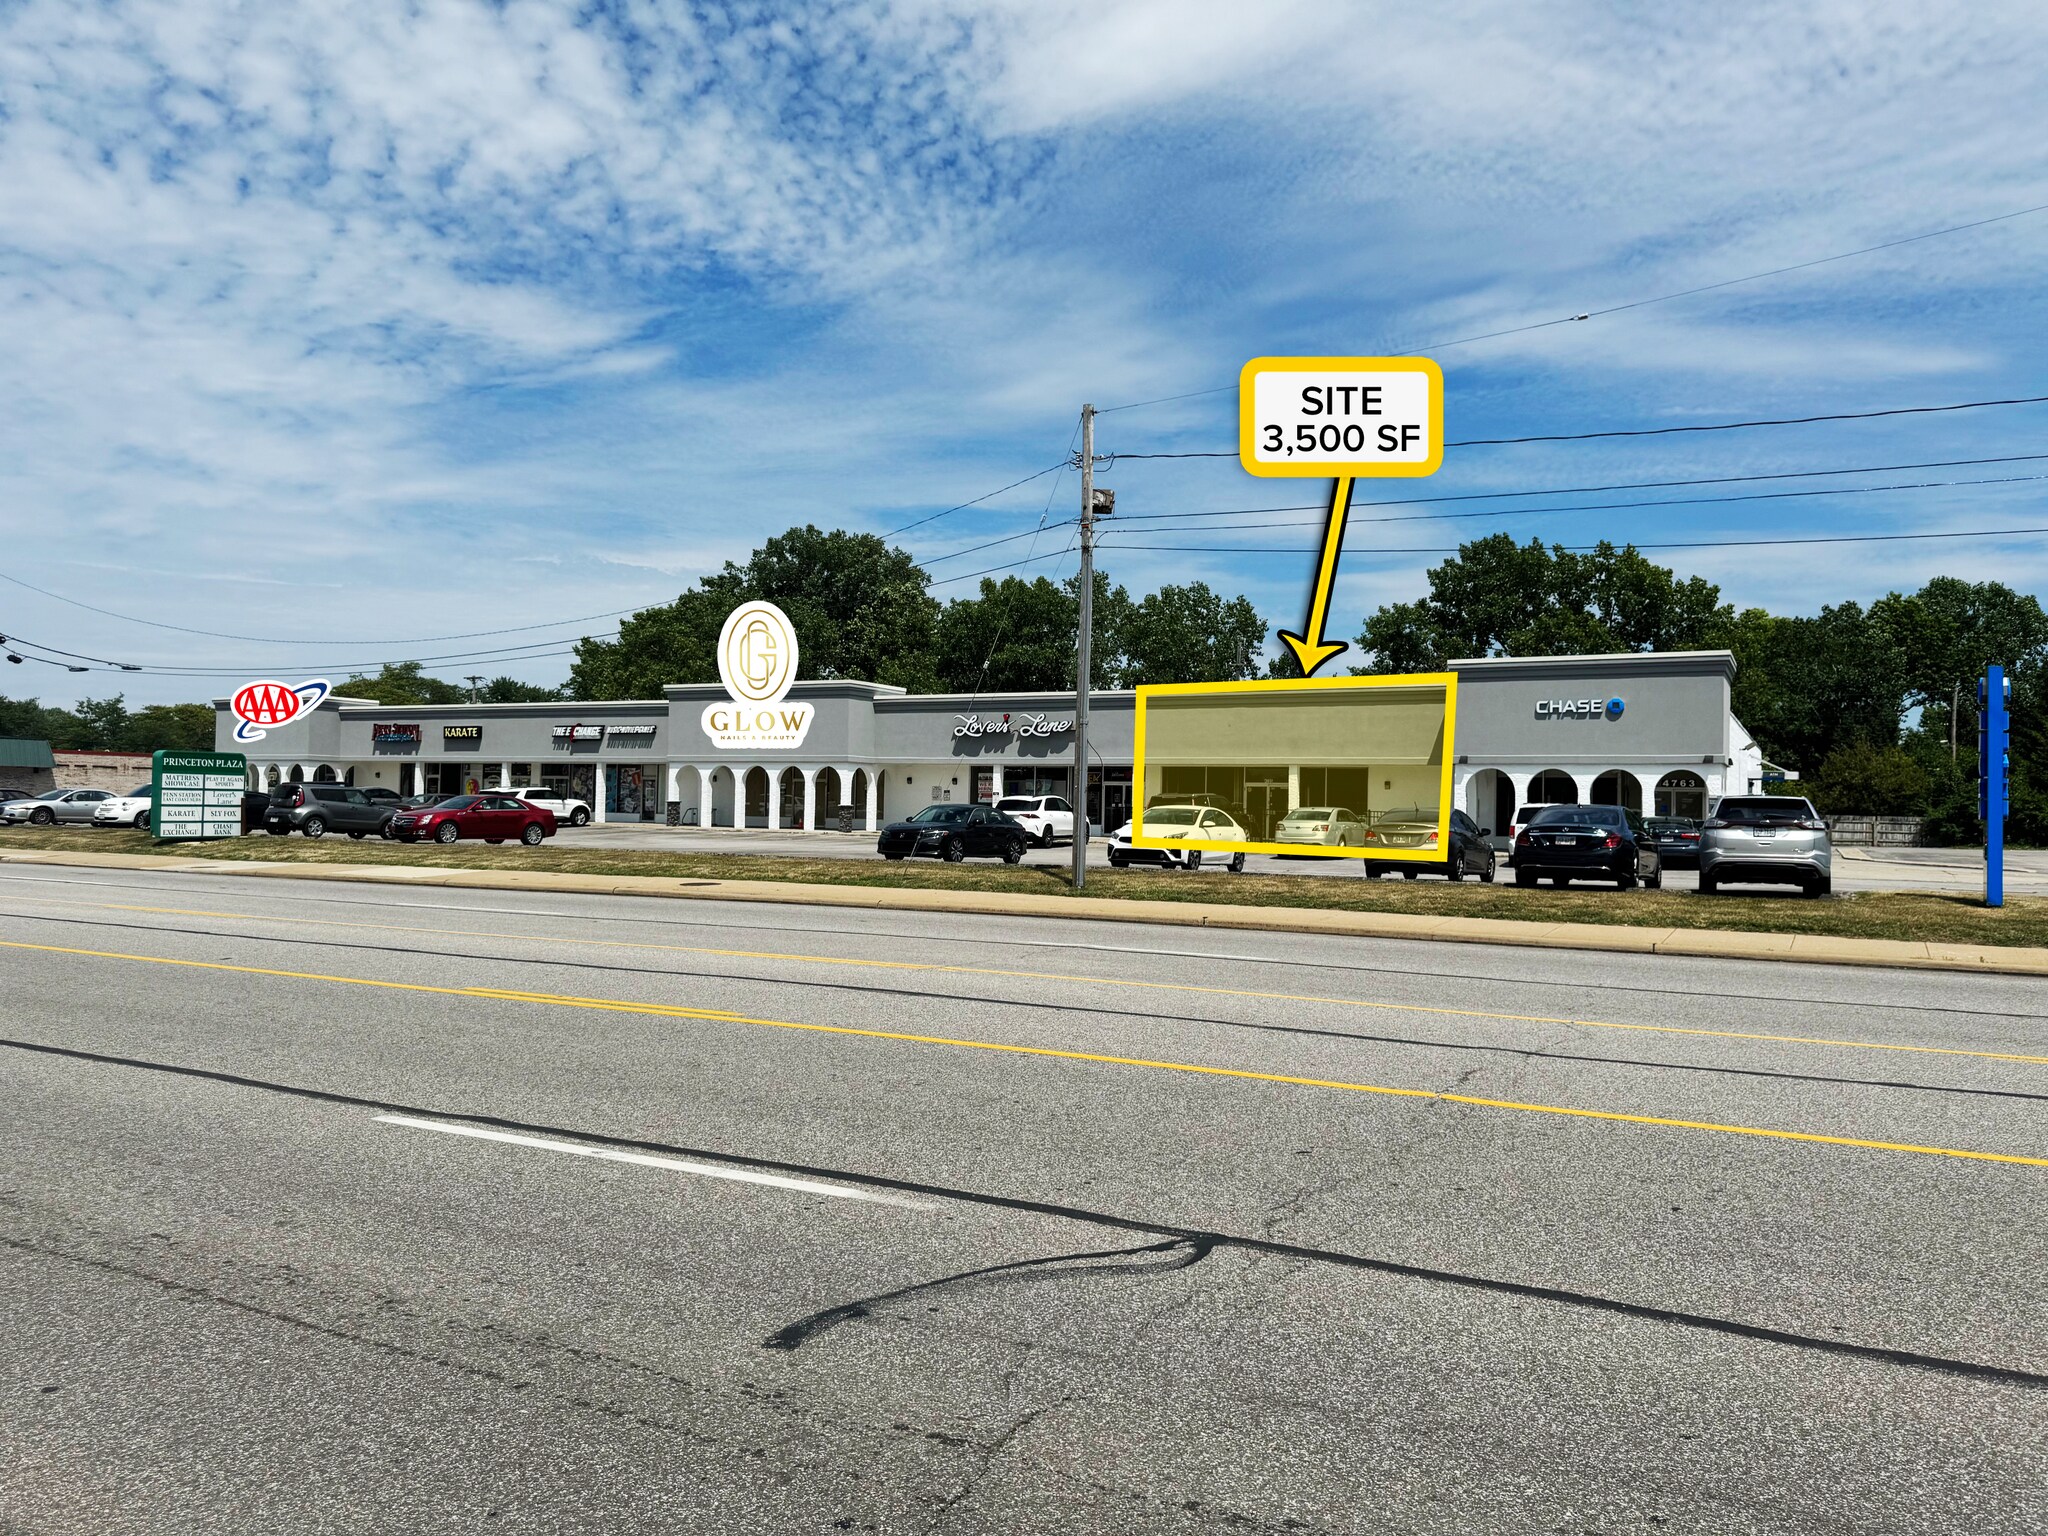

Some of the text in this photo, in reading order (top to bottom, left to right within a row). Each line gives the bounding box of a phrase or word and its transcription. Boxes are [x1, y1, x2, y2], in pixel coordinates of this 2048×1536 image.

[1535, 698, 1603, 714] CHASE
[953, 713, 1074, 738] Lover's Lane
[444, 727, 478, 737] KARATE
[552, 726, 566, 736] THE
[163, 758, 244, 768] PRINCETON PLAZA
[1662, 779, 1695, 787] 4763
